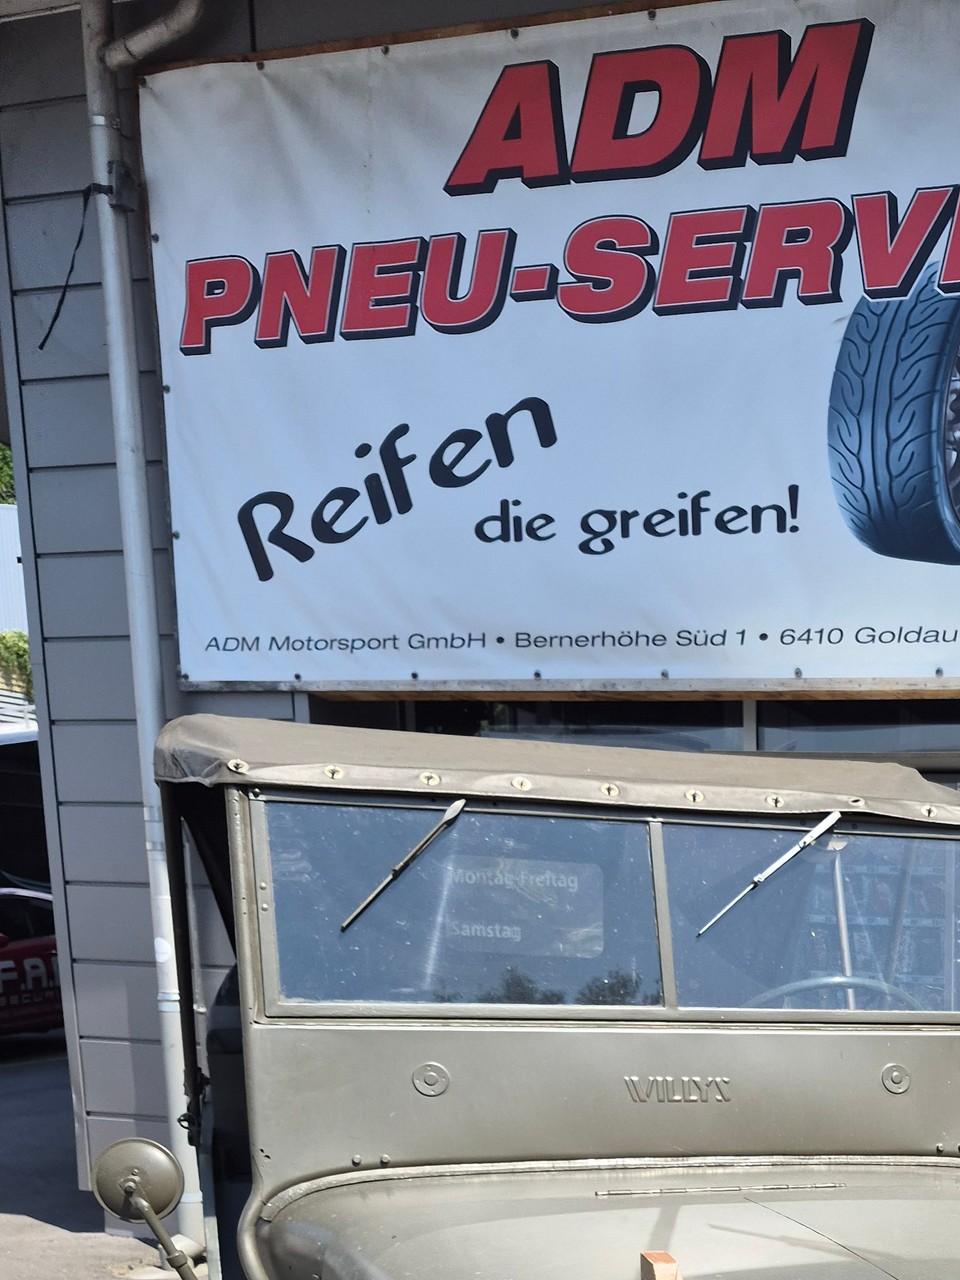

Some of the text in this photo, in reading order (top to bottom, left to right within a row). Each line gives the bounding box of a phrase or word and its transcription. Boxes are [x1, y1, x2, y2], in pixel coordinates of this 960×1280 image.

[443, 18, 875, 196] ADM
[237, 396, 558, 582] Reifen
[474, 483, 800, 556] die greifen!
[204, 636, 261, 652] ADM
[268, 635, 400, 655] Motorsport
[407, 631, 486, 650] GmbH
[515, 630, 668, 649] Bernerhöhe
[675, 628, 728, 647] Süd
[735, 628, 747, 646] 1
[779, 627, 844, 646] 6410
[854, 625, 959, 645] Goldau
[453, 922, 522, 942] Samstag
[623, 1076, 731, 1102] WILLYS
